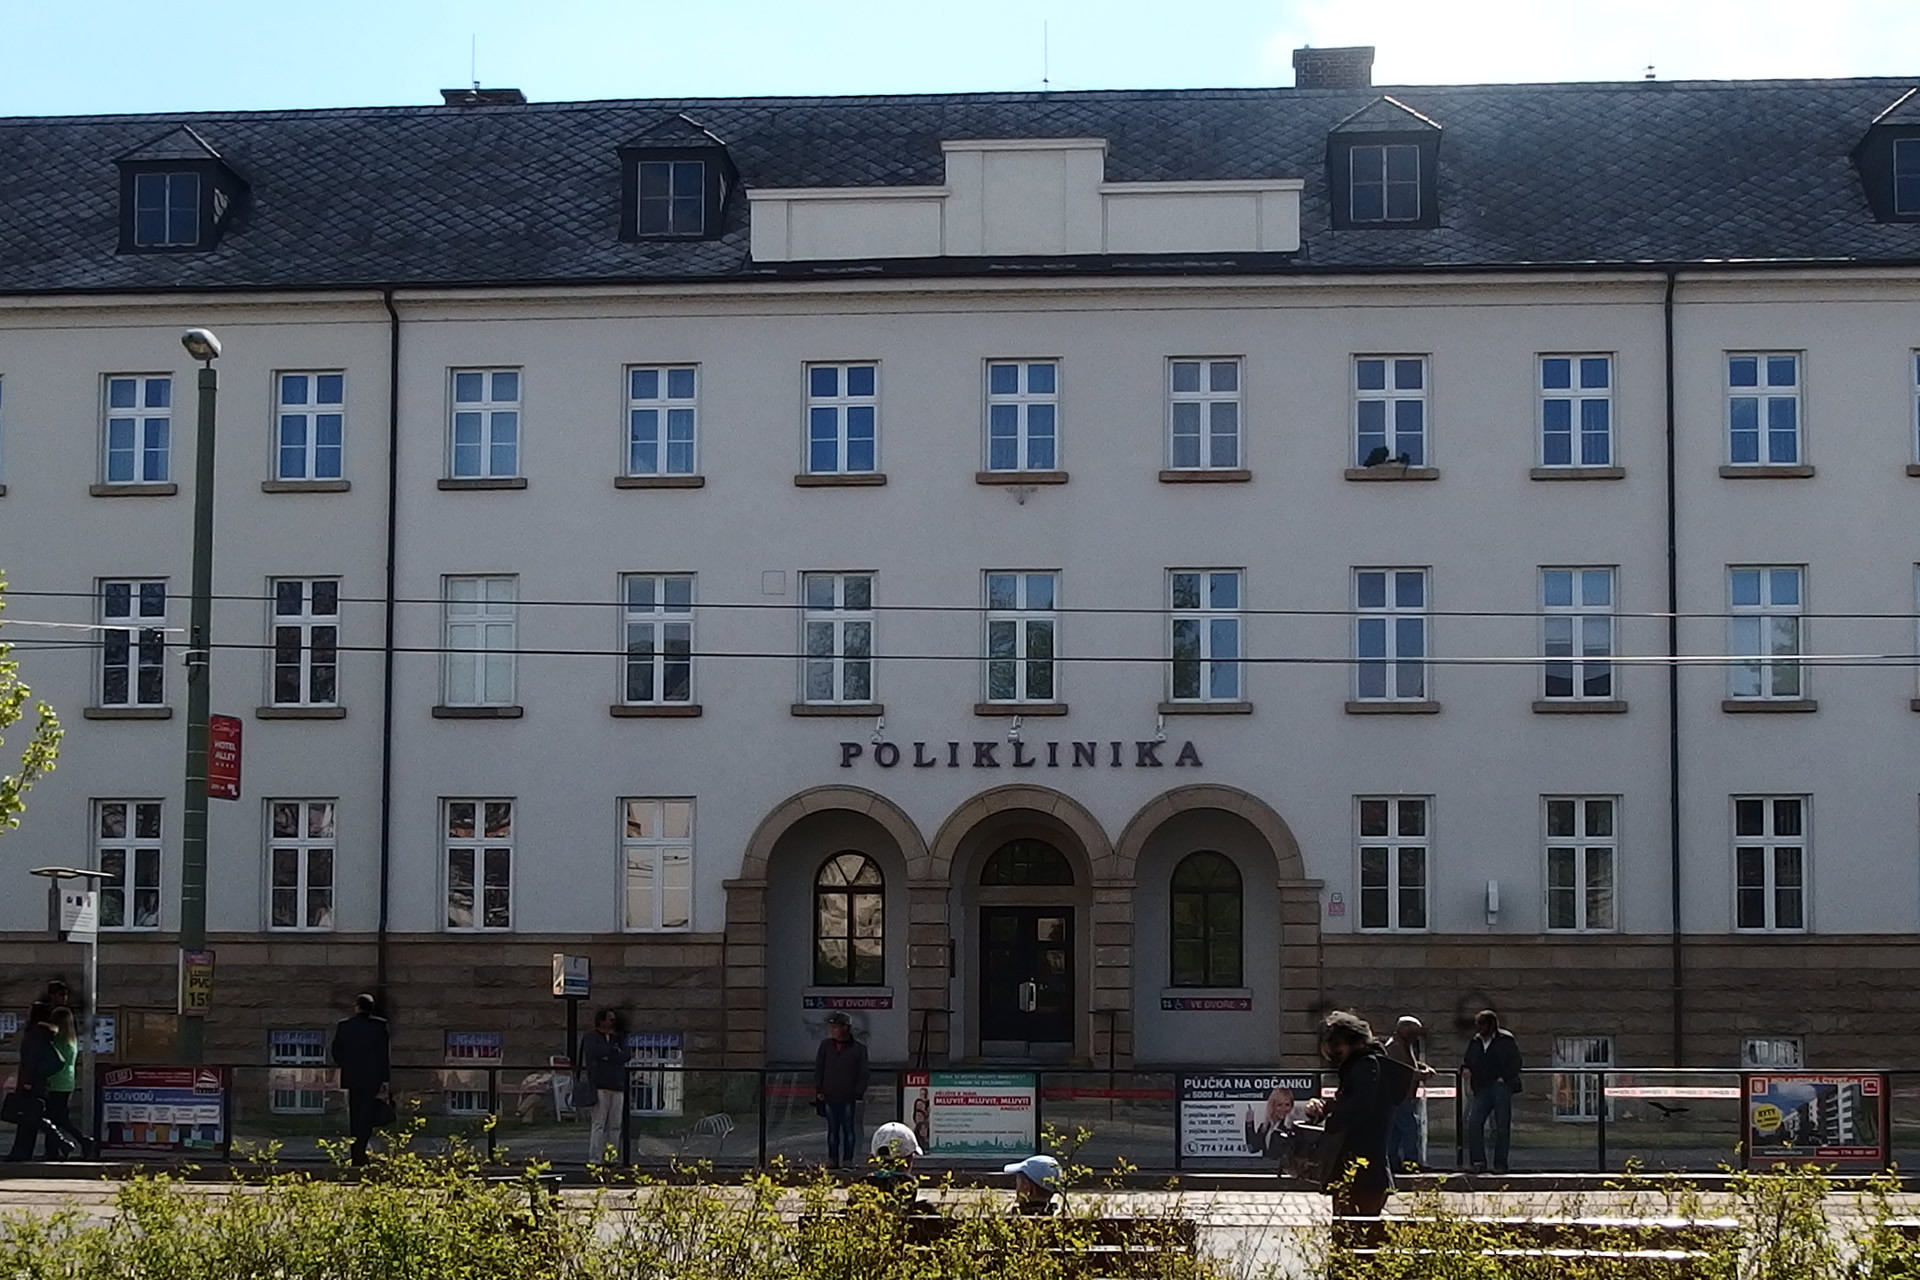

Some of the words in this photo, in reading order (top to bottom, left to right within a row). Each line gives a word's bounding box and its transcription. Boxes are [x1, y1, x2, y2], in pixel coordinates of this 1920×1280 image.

[214, 740, 237, 752] HOTEL
[214, 751, 236, 761] ALLEY
[840, 740, 1203, 768] POLIKLINIKA
[832, 998, 844, 1008] VE
[1191, 999, 1203, 1009] VE
[1183, 1076, 1232, 1090] PŮJČKA
[1234, 1079, 1252, 1090] NA
[1253, 1076, 1313, 1090] OBČANKU
[104, 1092, 112, 1102] 5
[114, 1089, 154, 1102] DŮVODŮ
[1192, 1090, 1213, 1099] 5000
[1214, 1090, 1225, 1099] Kč
[935, 1097, 967, 1106] MLUVIT,
[968, 1097, 999, 1106] MLUVIT,
[1000, 1097, 1030, 1105] MLUVIT
[1199, 1144, 1216, 1153] 774
[1218, 1144, 1234, 1153] 744
